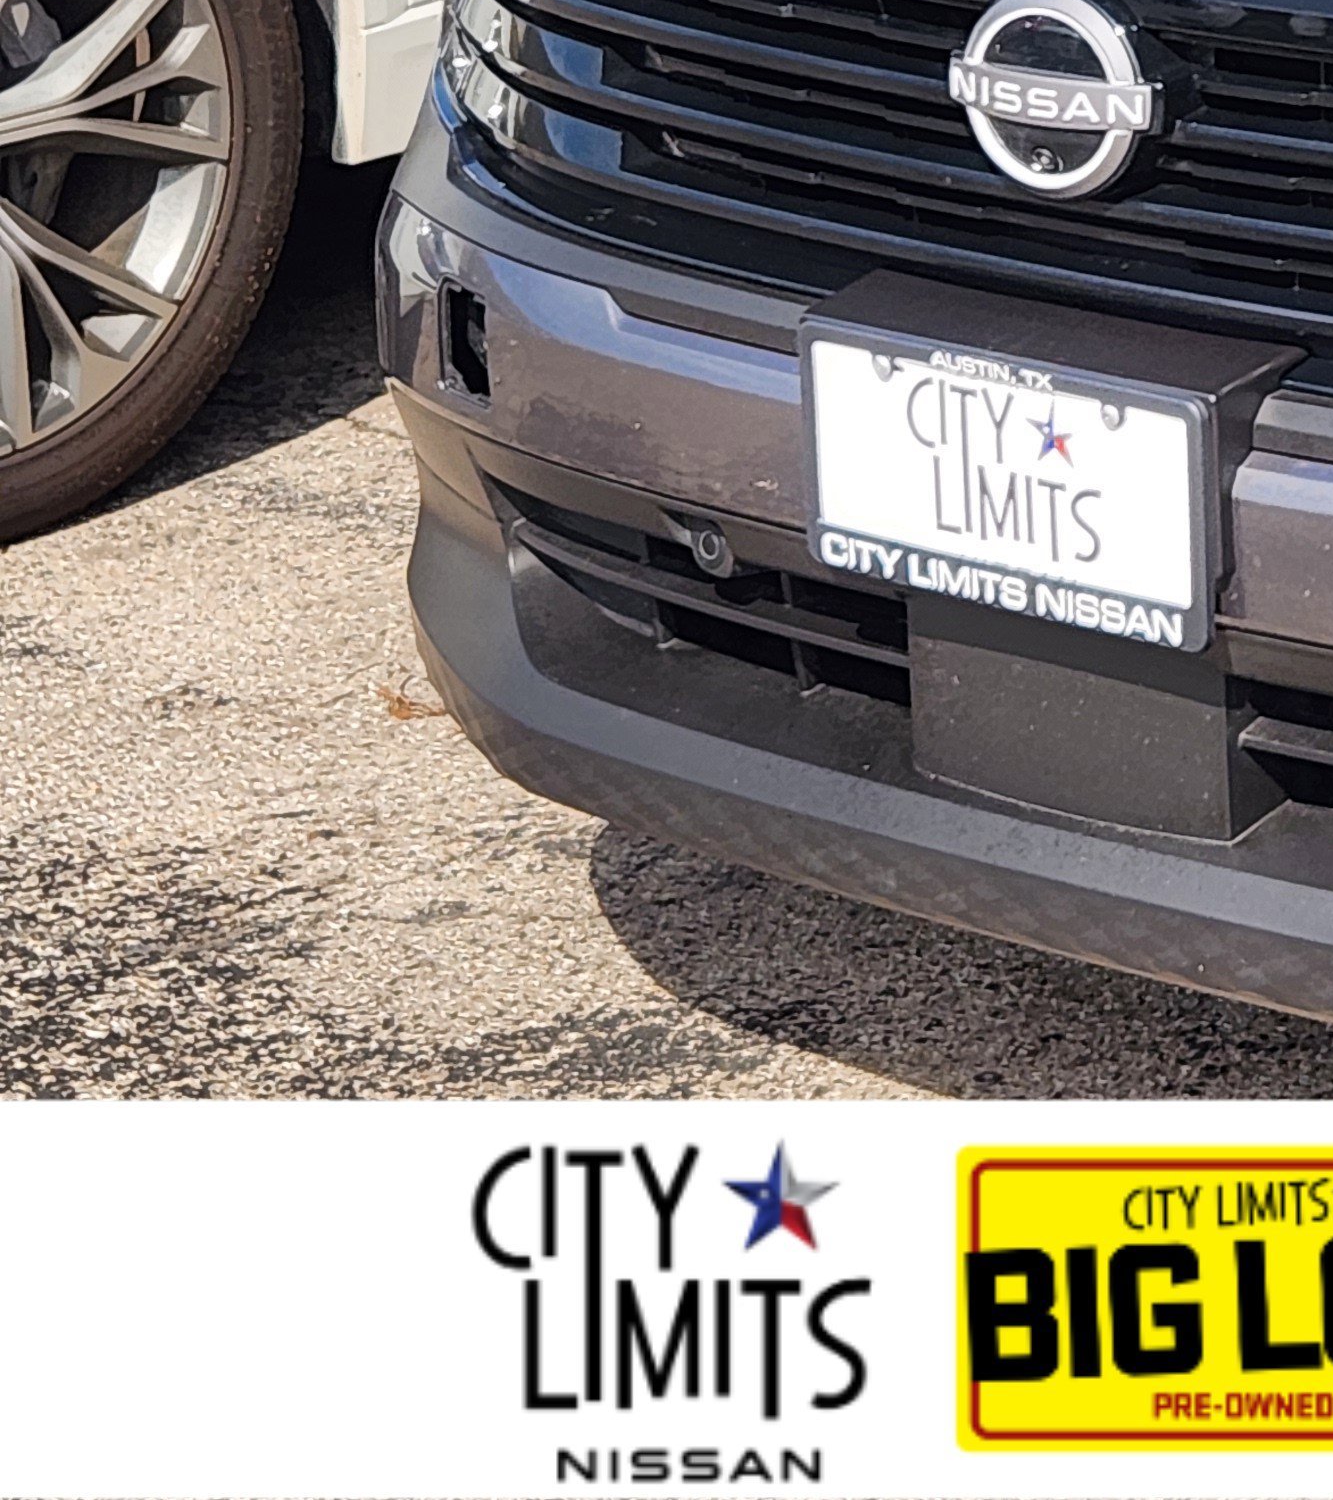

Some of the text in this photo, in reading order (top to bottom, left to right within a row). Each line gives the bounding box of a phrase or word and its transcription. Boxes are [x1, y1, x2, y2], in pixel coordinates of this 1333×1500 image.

[950, 65, 1148, 127] NISSAN
[929, 349, 1054, 391] AUSTIN, TX
[907, 376, 1014, 467] CITY
[933, 455, 1103, 563] LIMITS
[821, 531, 1184, 648] CITY LIMITS NISSAN
